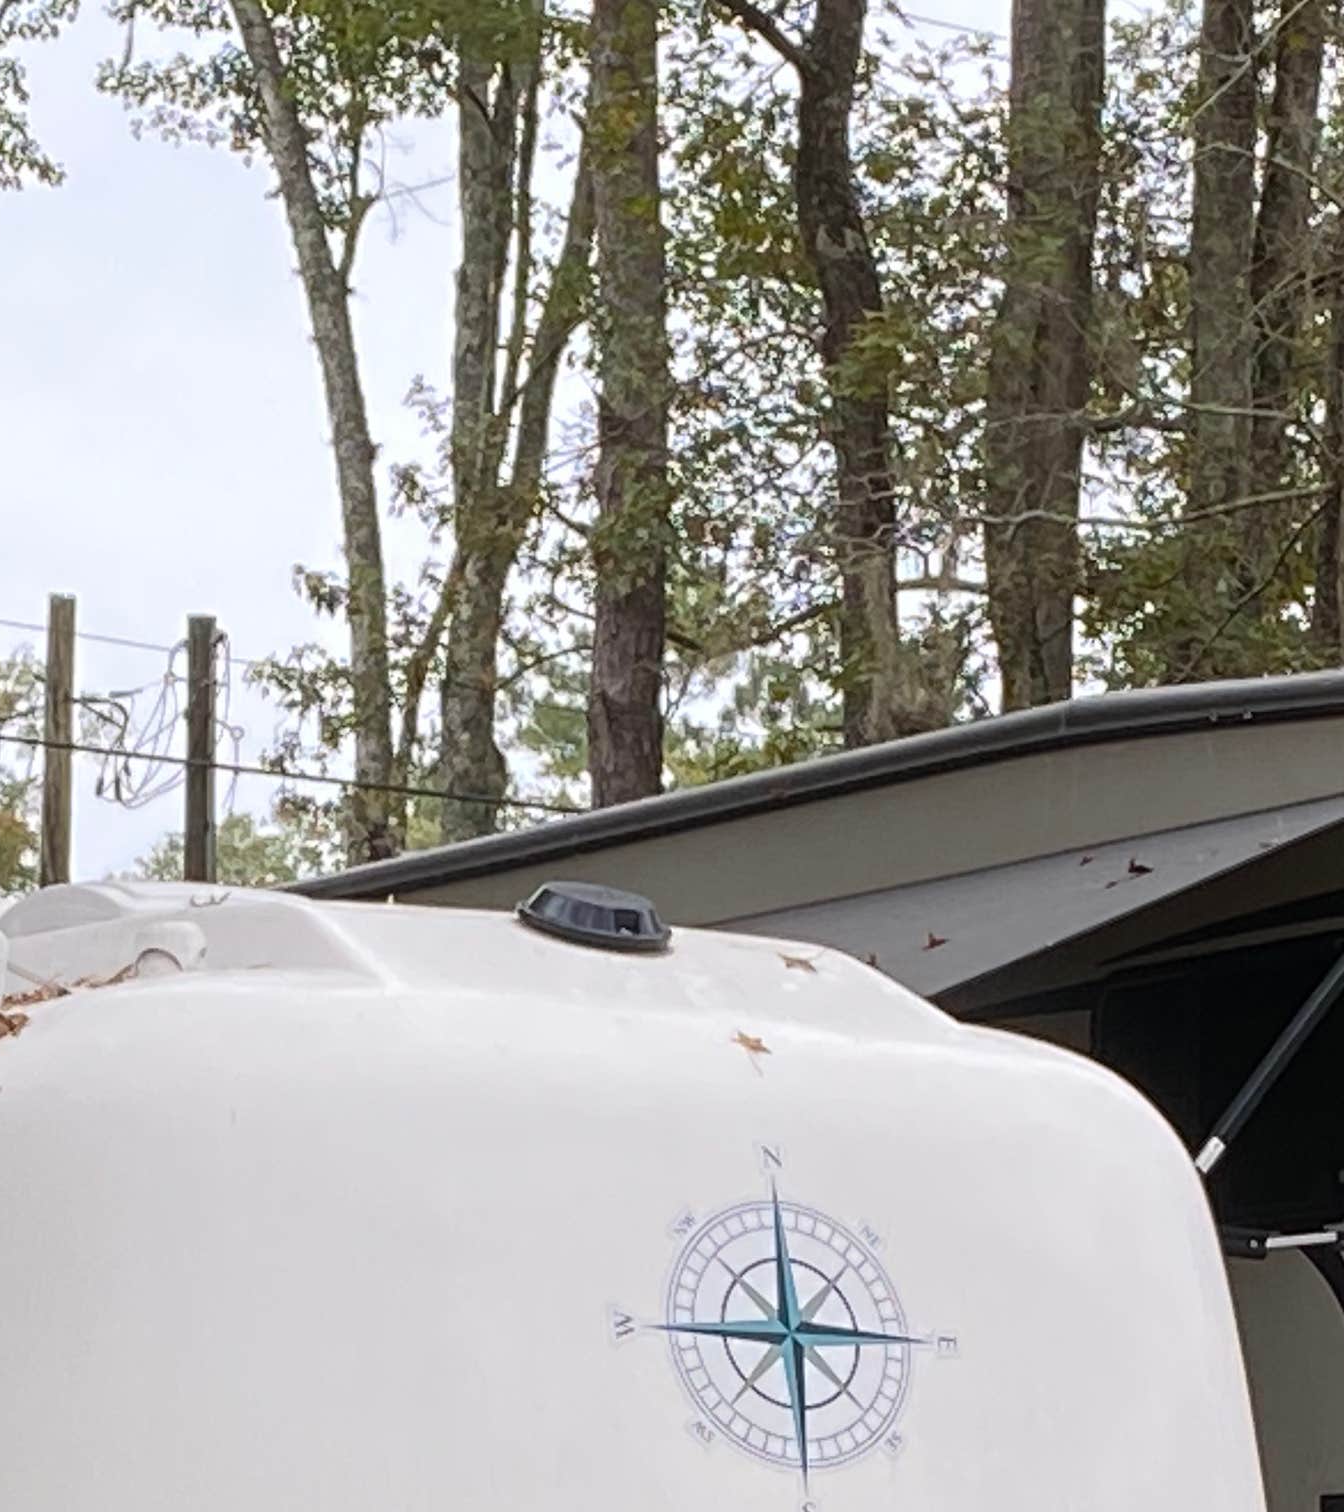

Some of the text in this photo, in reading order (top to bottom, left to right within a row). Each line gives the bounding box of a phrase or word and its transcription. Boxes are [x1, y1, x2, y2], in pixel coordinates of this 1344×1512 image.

[760, 1144, 783, 1169] N
[613, 1310, 635, 1340] W
[937, 1335, 958, 1352] E
